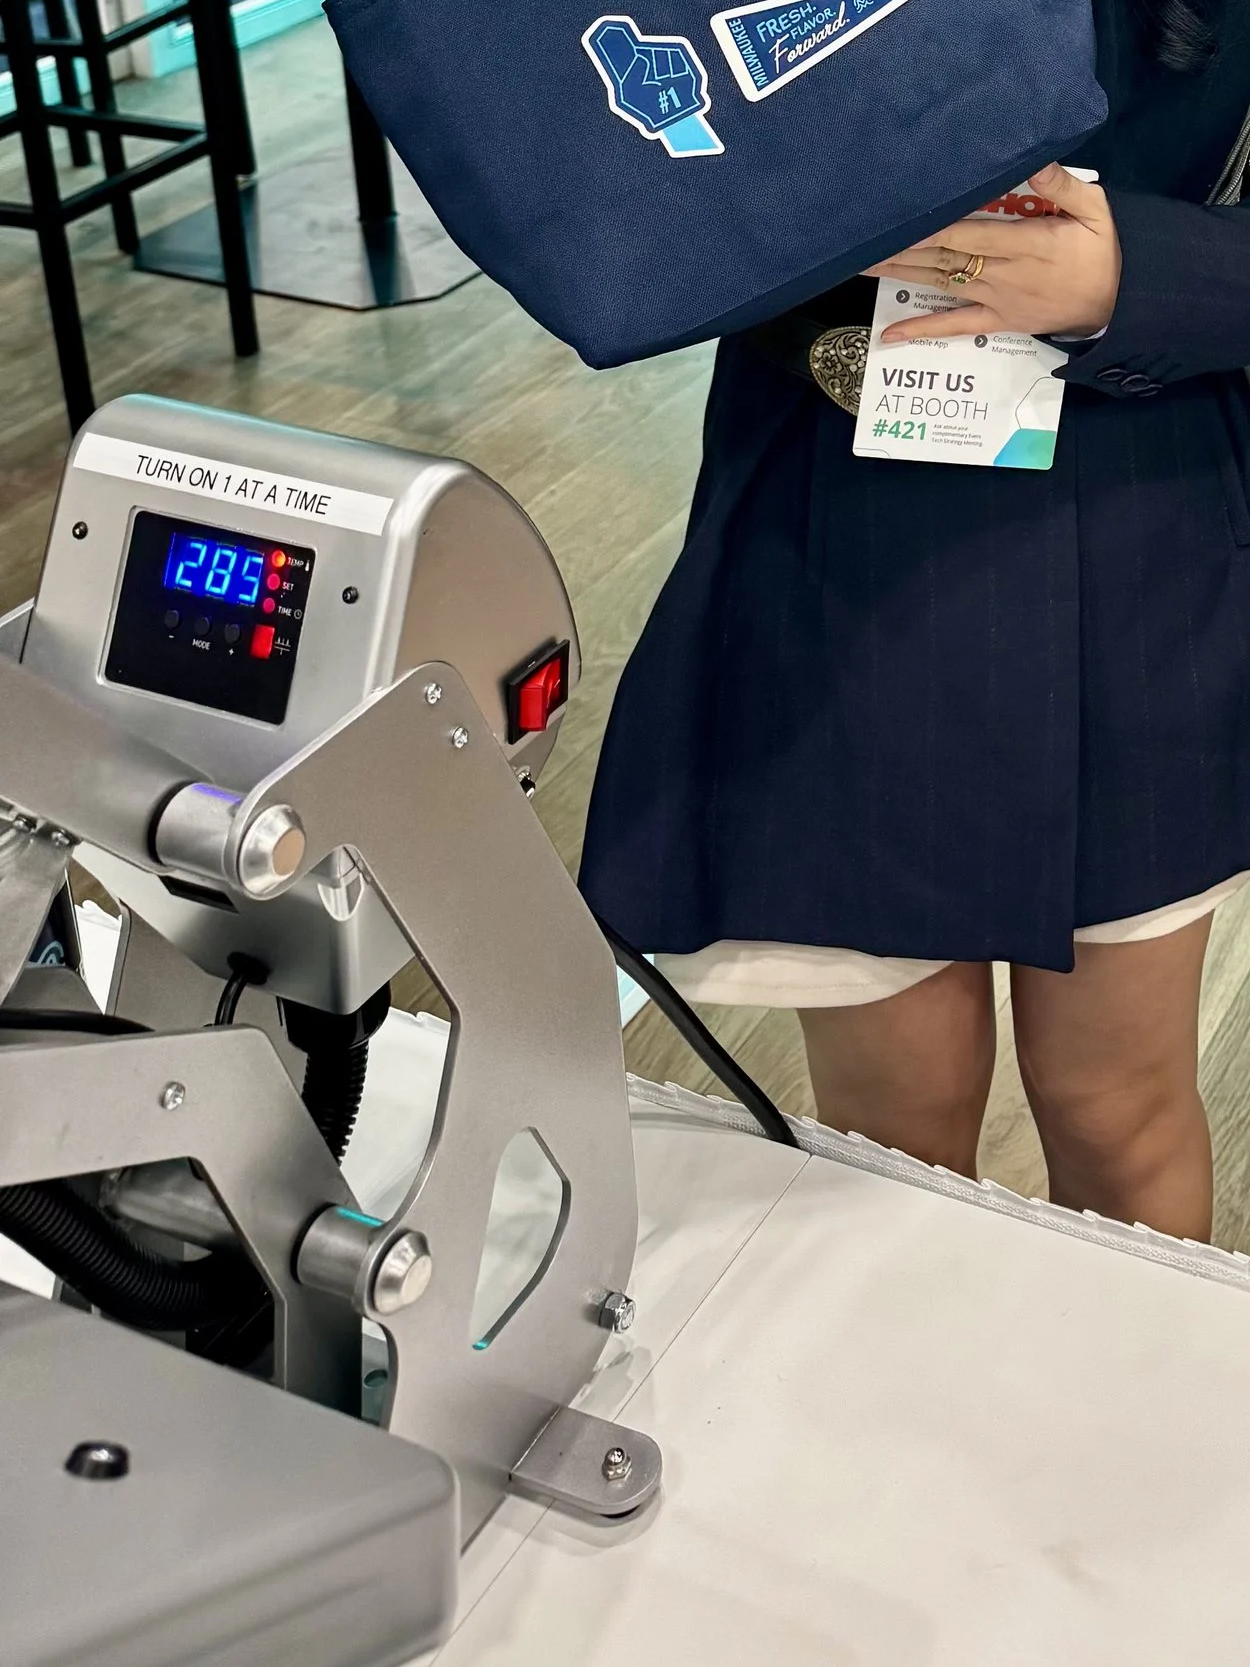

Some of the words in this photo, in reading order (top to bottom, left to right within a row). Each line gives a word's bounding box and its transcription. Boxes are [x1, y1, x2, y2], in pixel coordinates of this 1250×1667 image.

[756, 2, 817, 43] FRESH.
[791, 7, 837, 40] FLAVOR.
[768, 0, 851, 74] Forward.
[728, 18, 769, 87] MILWAUKEE
[658, 86, 683, 115] #1
[914, 301, 951, 313] Managem
[915, 291, 958, 304] Registration
[908, 338, 933, 348] Mobile
[934, 340, 949, 350] App
[992, 346, 1037, 358] Management
[993, 335, 1033, 347] Conference
[882, 367, 939, 390] VISIT
[945, 373, 975, 393] US
[875, 394, 905, 413] AT
[910, 396, 989, 421] BOOTH
[872, 418, 927, 441] #421
[136, 454, 186, 483] TURN
[189, 467, 218, 491] ON
[223, 474, 232, 493] 1
[235, 477, 264, 500] AT
[264, 484, 277, 504] A
[285, 487, 332, 515] TIME
[174, 541, 264, 604] 285
[287, 556, 304, 567] TEMP
[282, 581, 294, 591] SET
[278, 605, 292, 617] TIME
[192, 638, 211, 651] MODE
